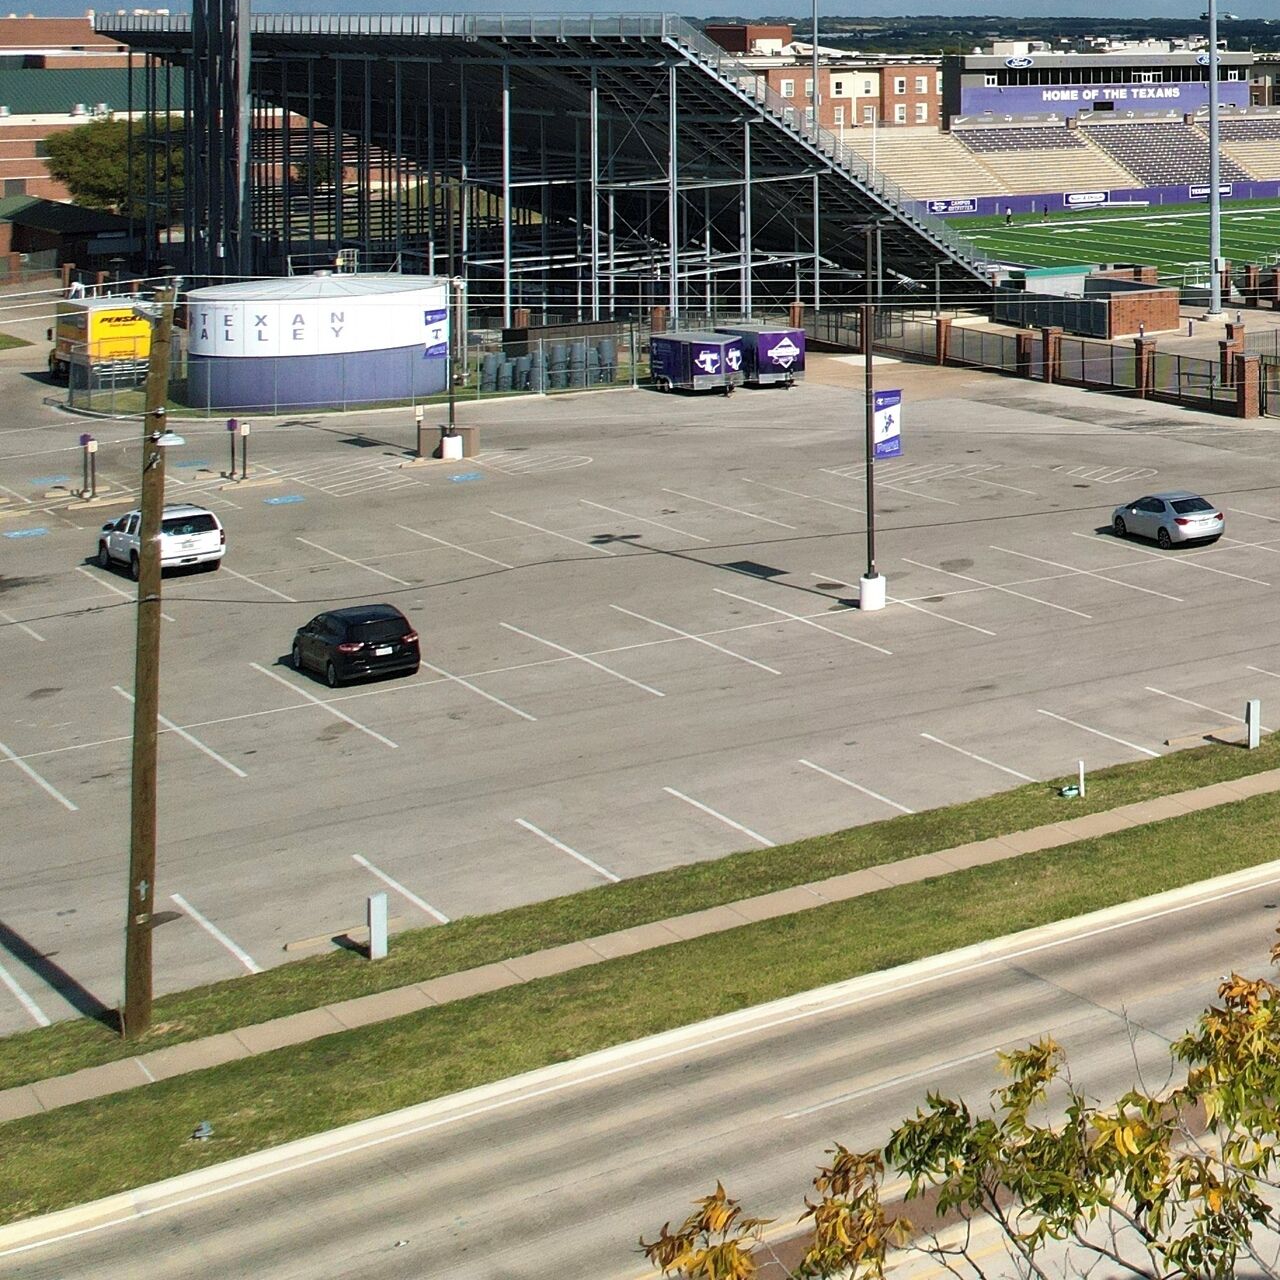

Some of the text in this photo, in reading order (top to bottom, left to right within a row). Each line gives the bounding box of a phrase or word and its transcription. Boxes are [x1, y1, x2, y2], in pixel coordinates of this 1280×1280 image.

[1042, 87, 1180, 101] HOME OF THE TEXANS
[200, 311, 345, 327] TEXAN
